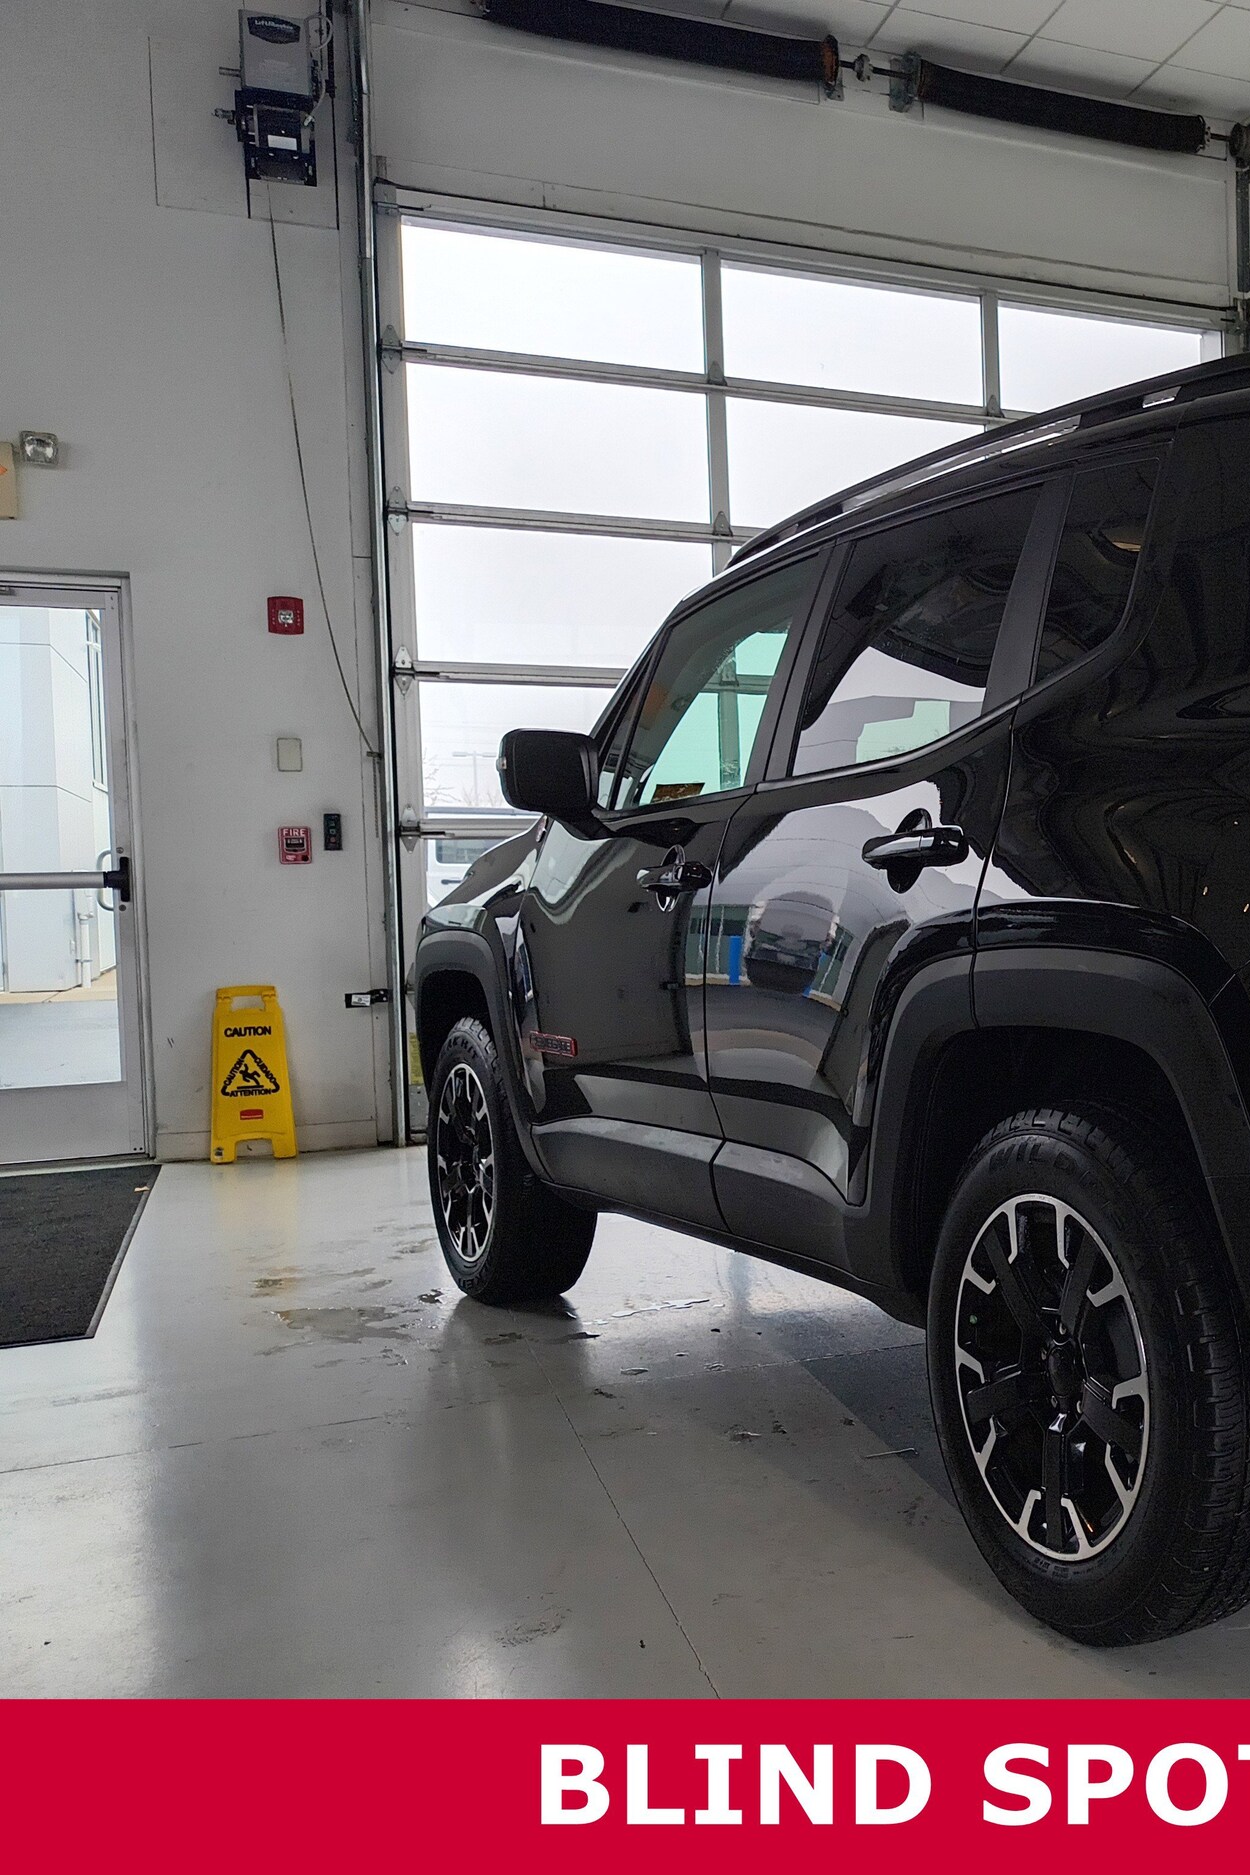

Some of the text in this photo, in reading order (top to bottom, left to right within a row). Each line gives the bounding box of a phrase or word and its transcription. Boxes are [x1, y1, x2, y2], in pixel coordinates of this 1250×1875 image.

[283, 828, 306, 837] FIRE
[223, 1026, 272, 1038] CAUTION
[223, 1057, 245, 1086] CAUTION
[254, 1057, 277, 1084] CUIDADO
[229, 1088, 273, 1098] ATTENTION
